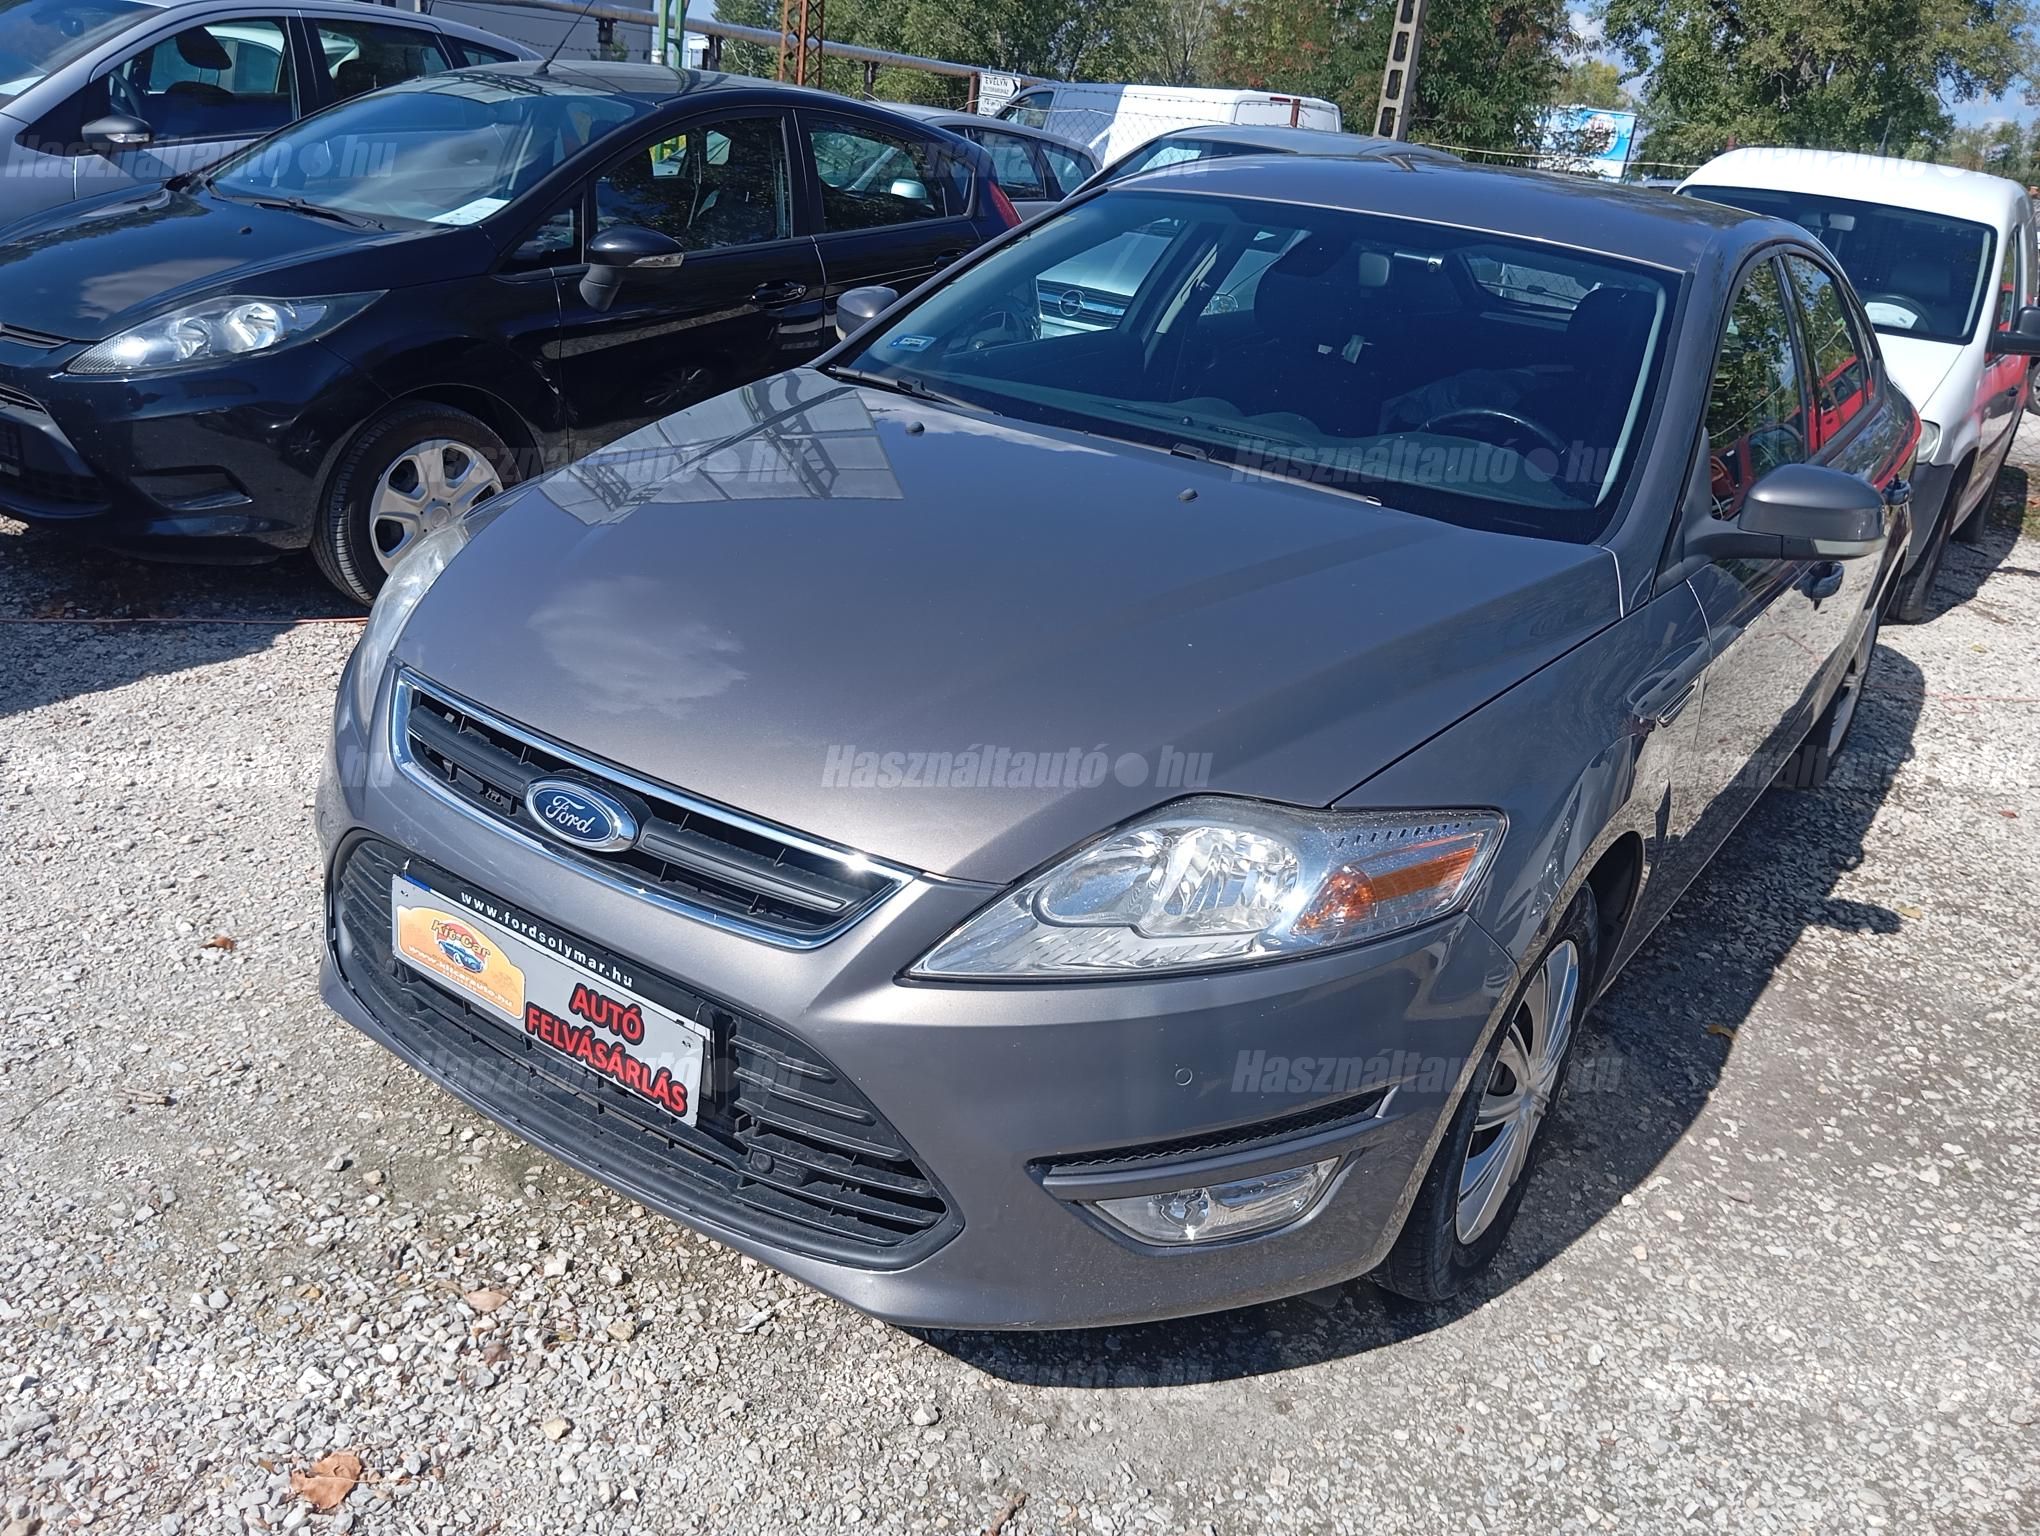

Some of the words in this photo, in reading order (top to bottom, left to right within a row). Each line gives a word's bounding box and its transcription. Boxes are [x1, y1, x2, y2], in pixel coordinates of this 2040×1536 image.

[545, 795, 597, 834] Ford
[431, 919, 491, 957] Kit-Car
[461, 892, 633, 988] www.fordsolymar.hu
[570, 984, 644, 1044] AUTÓ
[526, 1003, 688, 1115] FELVÁSÁRLÁS
